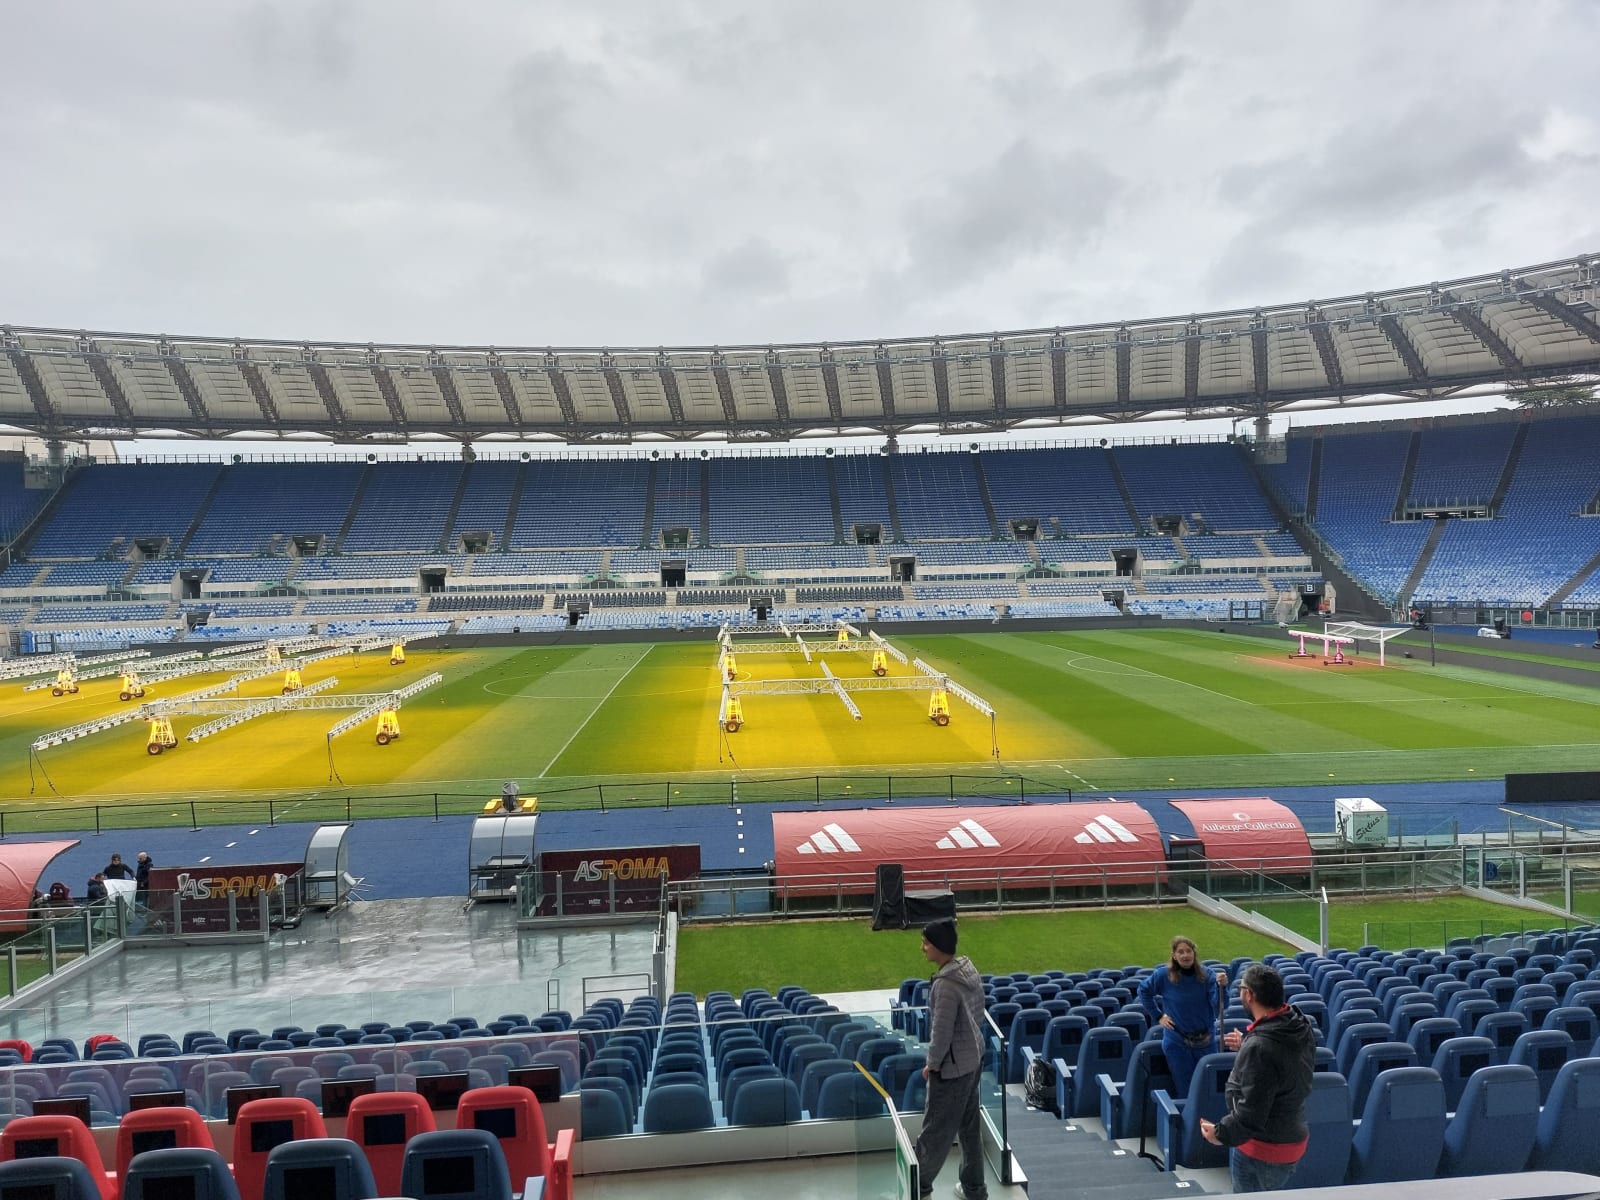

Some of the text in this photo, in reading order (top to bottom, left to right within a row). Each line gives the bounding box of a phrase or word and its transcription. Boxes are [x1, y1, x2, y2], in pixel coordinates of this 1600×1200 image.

[1306, 584, 1314, 592] B
[1202, 821, 1296, 832] Auberge Collection
[1355, 816, 1381, 841] Sixtus
